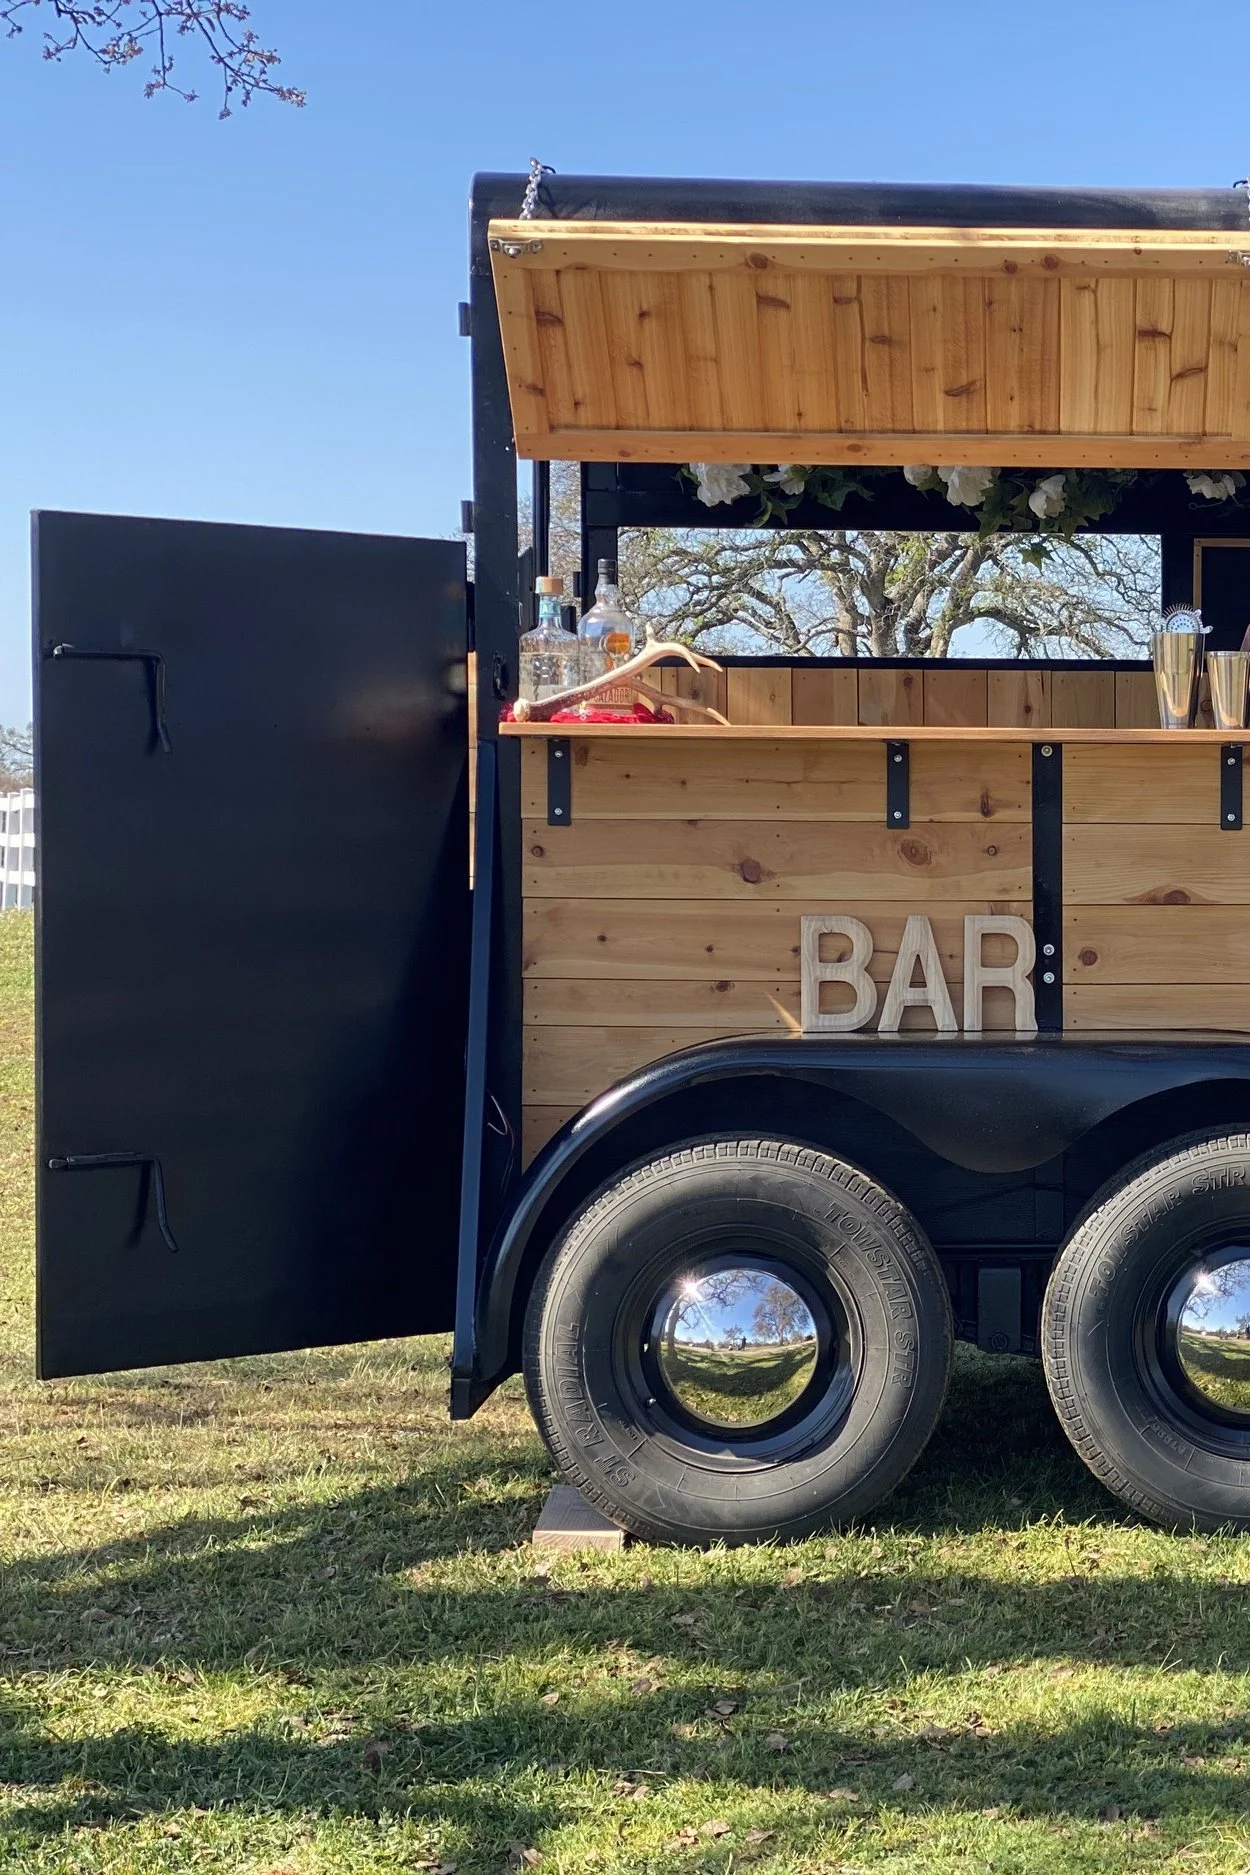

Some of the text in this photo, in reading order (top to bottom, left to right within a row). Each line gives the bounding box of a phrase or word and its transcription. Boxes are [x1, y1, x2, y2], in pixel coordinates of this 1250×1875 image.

[801, 915, 1038, 1032] BAR
[824, 1201, 915, 1388] TOWSTAR STR
[1088, 1165, 1246, 1298] TOWSTAR STR
[556, 1322, 604, 1448] RADIAL
[593, 1454, 636, 1487] ST
